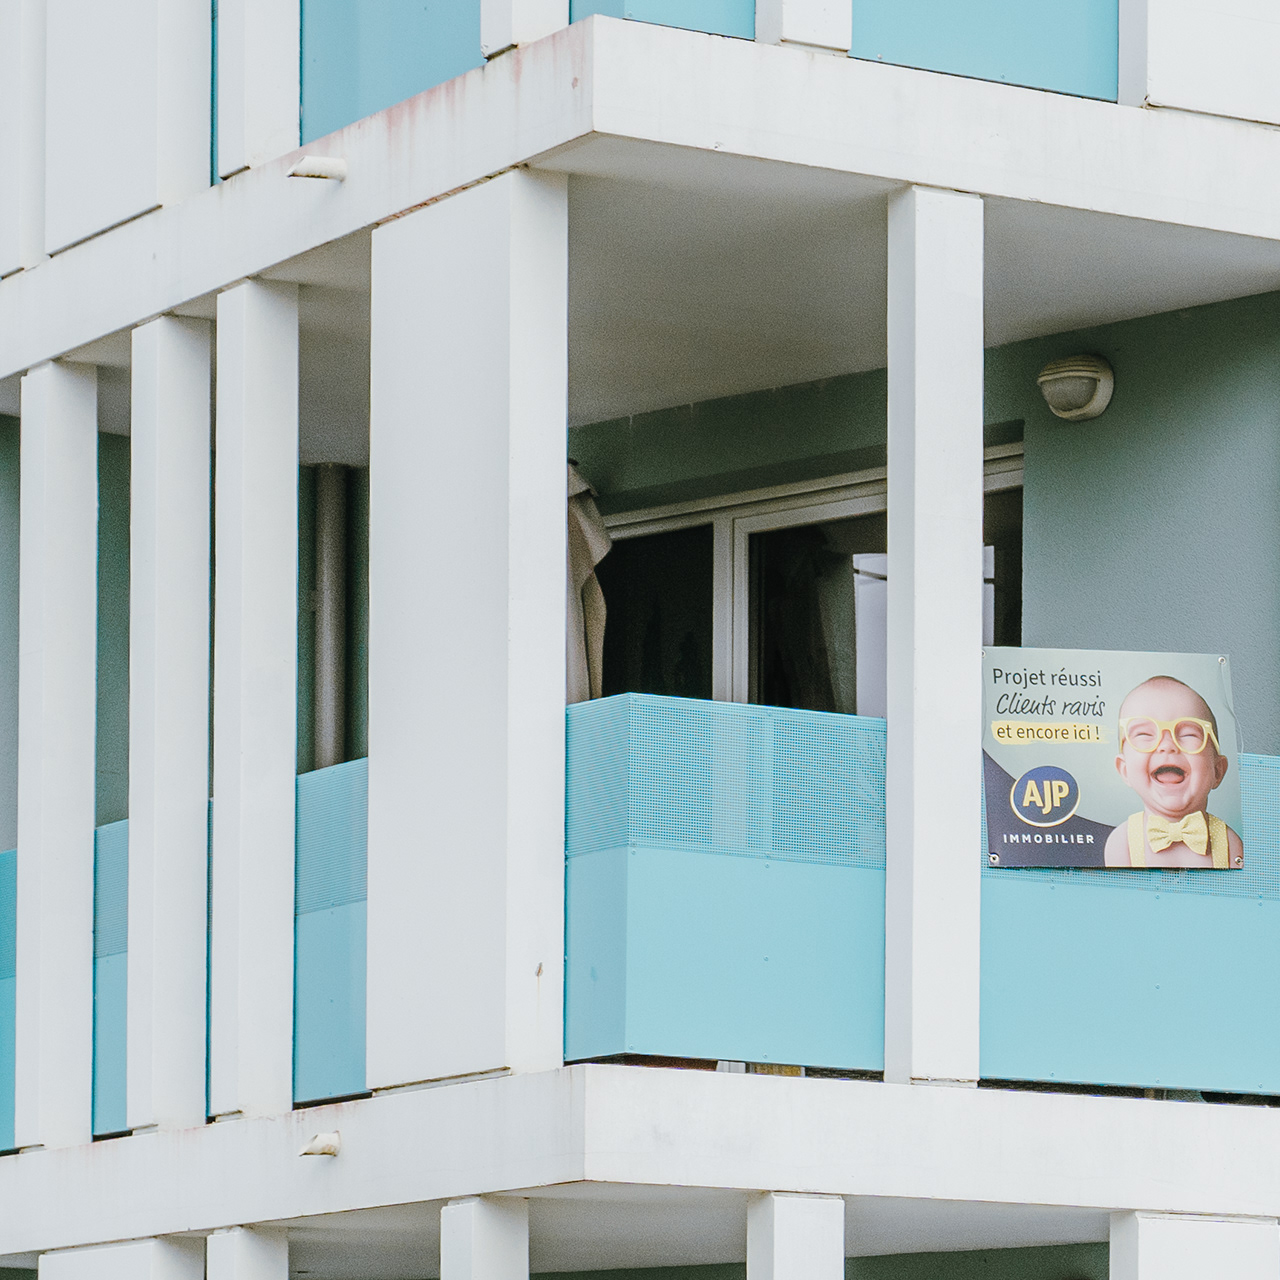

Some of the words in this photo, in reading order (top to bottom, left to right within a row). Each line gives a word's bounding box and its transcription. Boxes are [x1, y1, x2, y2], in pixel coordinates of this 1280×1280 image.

[993, 668, 1046, 689] Projet
[1051, 667, 1102, 687] réussi
[996, 692, 1056, 716] Clients
[1061, 695, 1105, 717] ravis
[997, 725, 1012, 739] et
[1016, 727, 1069, 740] encore
[1073, 725, 1090, 740] ici
[1022, 779, 1070, 815] AJP
[1003, 833, 1095, 844] IMMOBILIER
